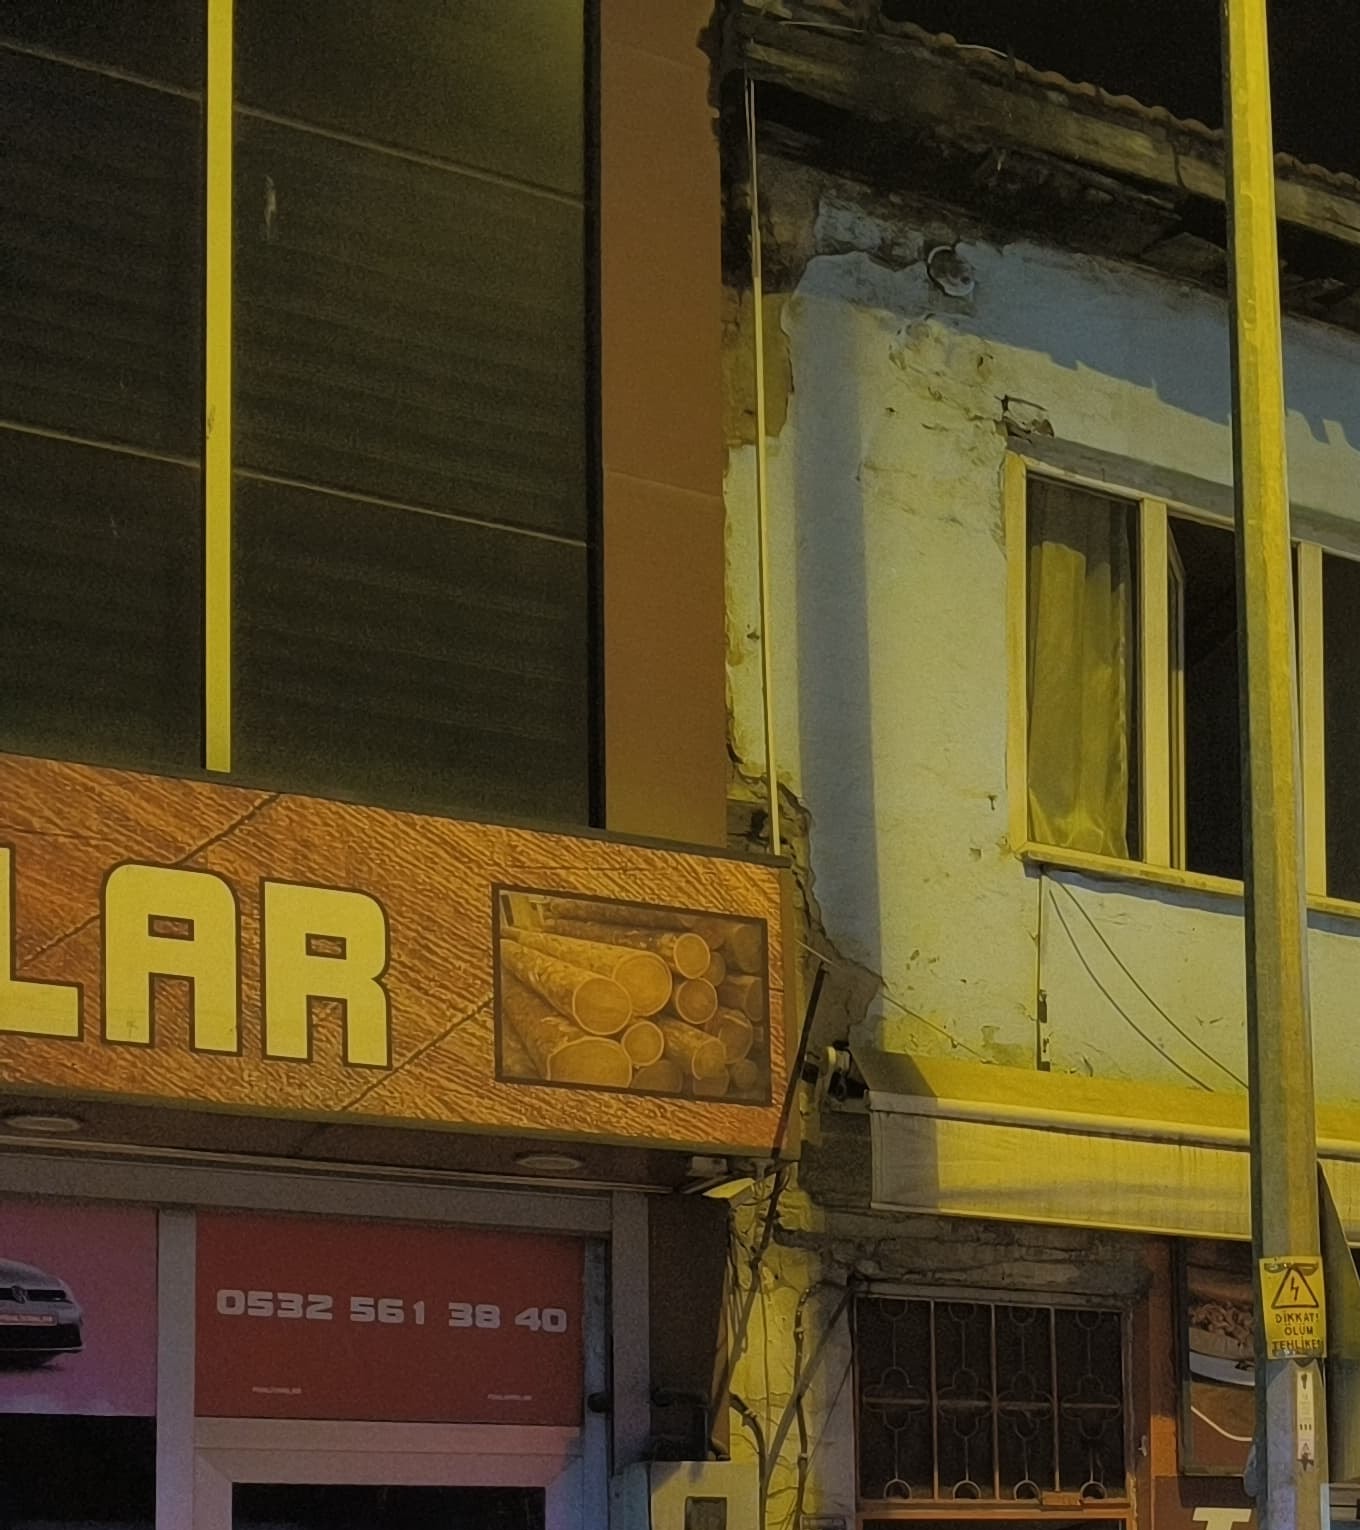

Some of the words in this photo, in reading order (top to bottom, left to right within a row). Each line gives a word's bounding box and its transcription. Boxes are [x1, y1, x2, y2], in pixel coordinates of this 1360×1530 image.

[217, 1289, 333, 1320] 0532
[351, 1297, 425, 1325] 561
[449, 1303, 501, 1329] 38
[515, 1308, 567, 1333] 40
